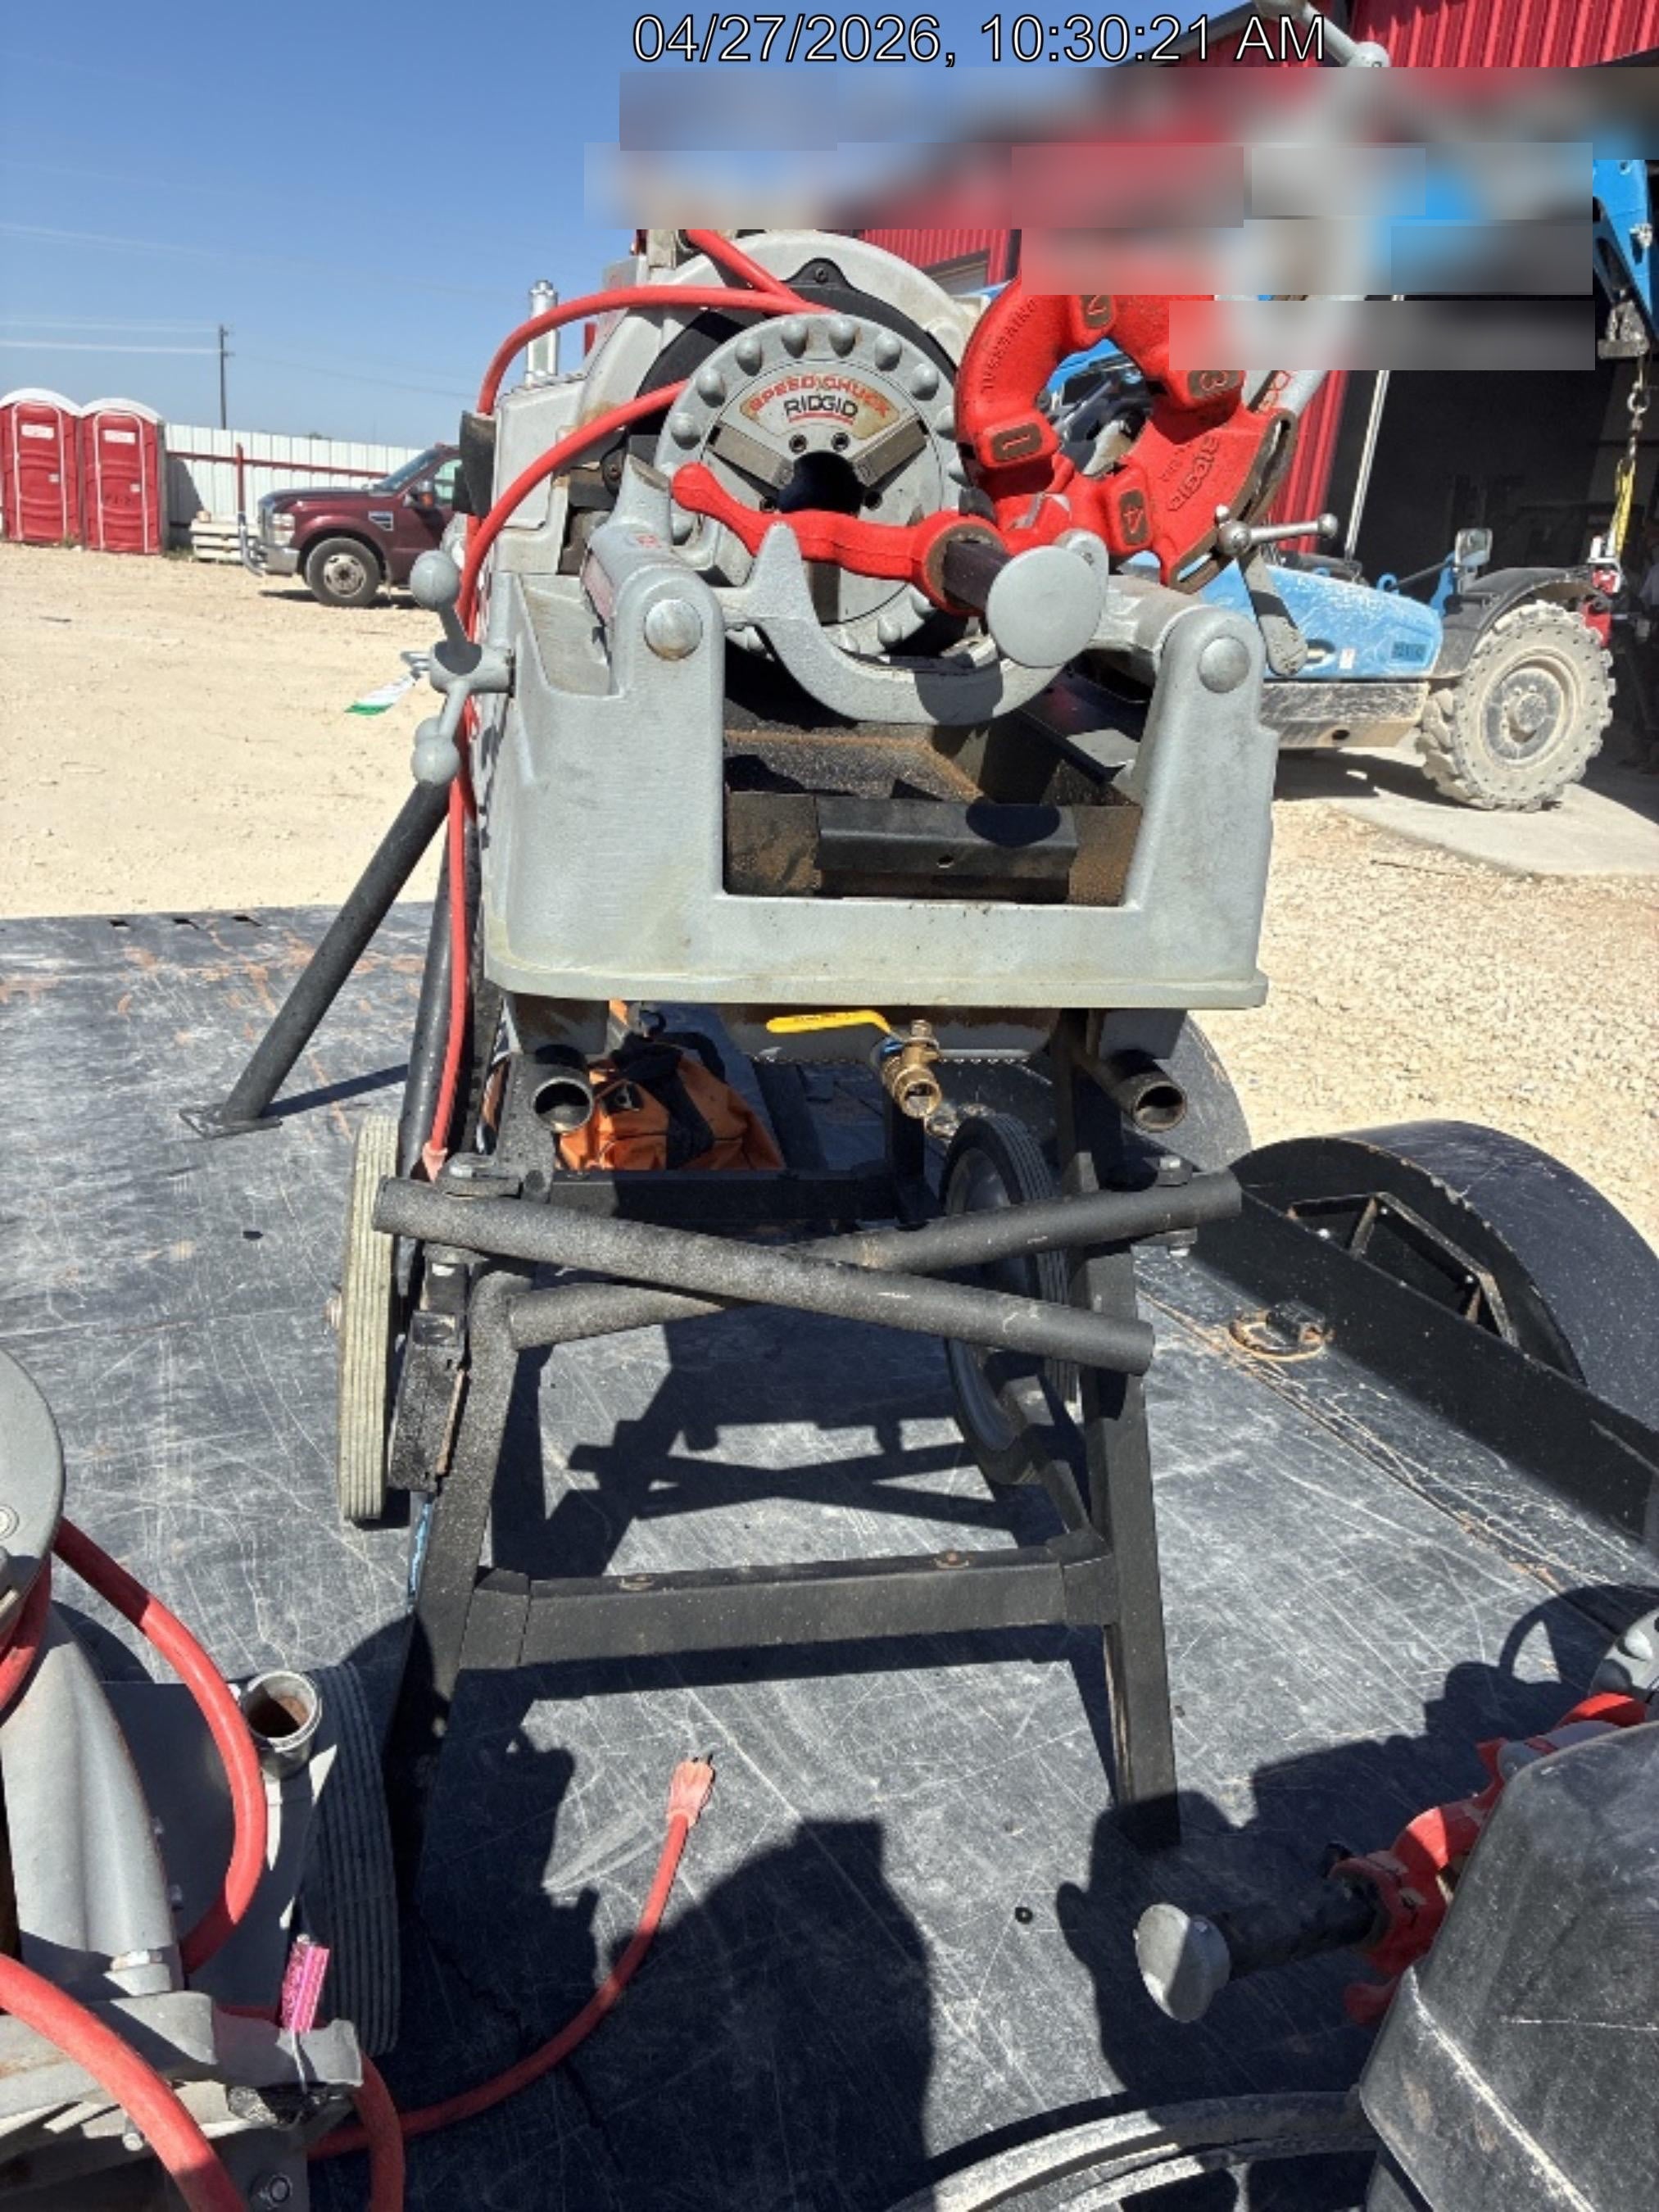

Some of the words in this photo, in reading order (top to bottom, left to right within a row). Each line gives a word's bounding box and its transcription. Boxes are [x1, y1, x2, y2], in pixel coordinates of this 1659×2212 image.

[749, 375, 817, 411] SPEED
[823, 375, 888, 419] CHUCK
[784, 395, 859, 418] RIDGID
